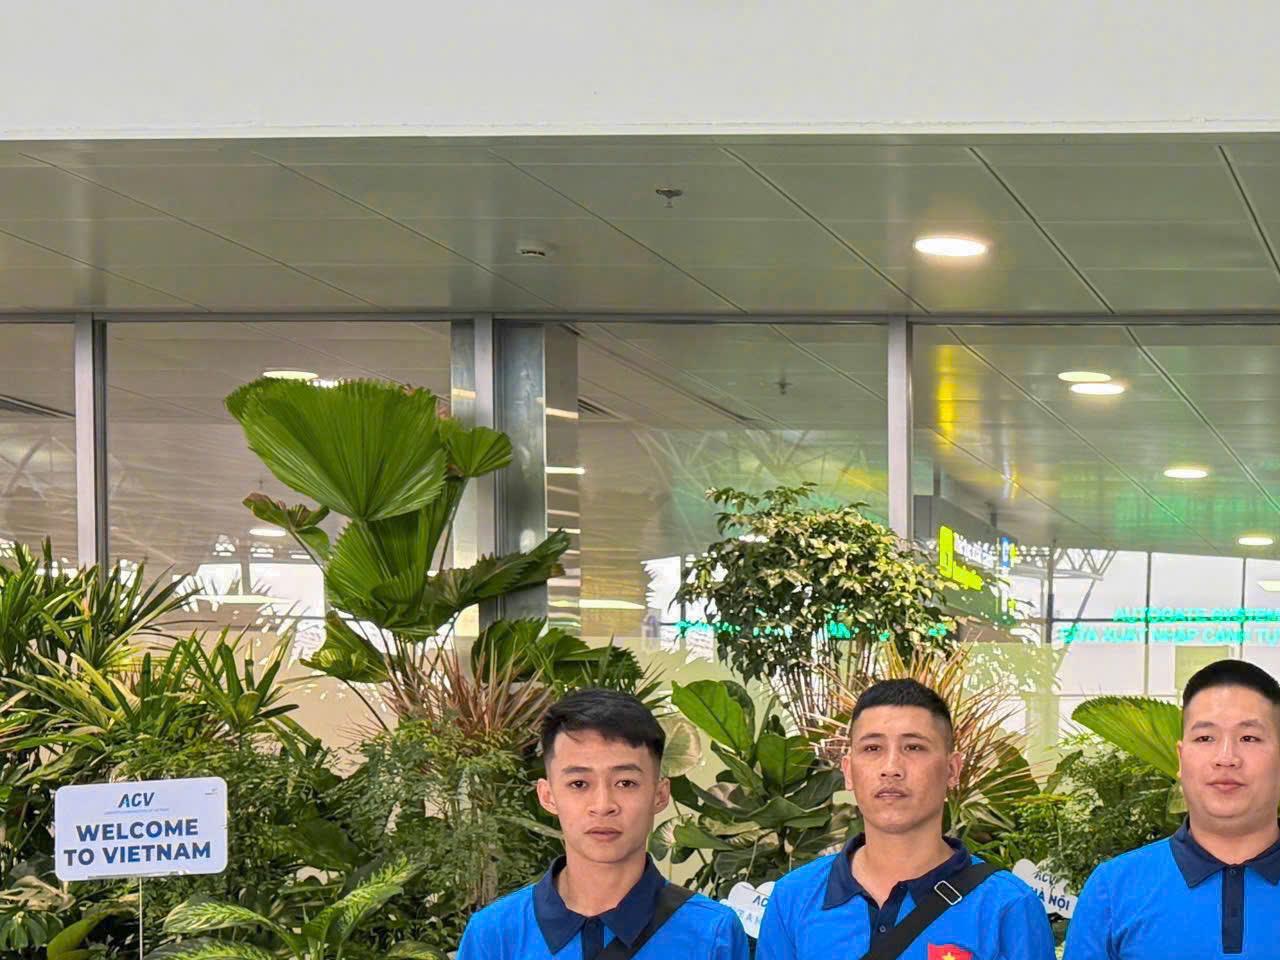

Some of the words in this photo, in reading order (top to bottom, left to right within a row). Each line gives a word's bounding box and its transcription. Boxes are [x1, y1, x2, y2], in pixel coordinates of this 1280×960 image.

[118, 792, 154, 808] ACV
[76, 818, 199, 842] WELCOME
[64, 848, 95, 866] TO
[102, 841, 211, 864] VIETNAM
